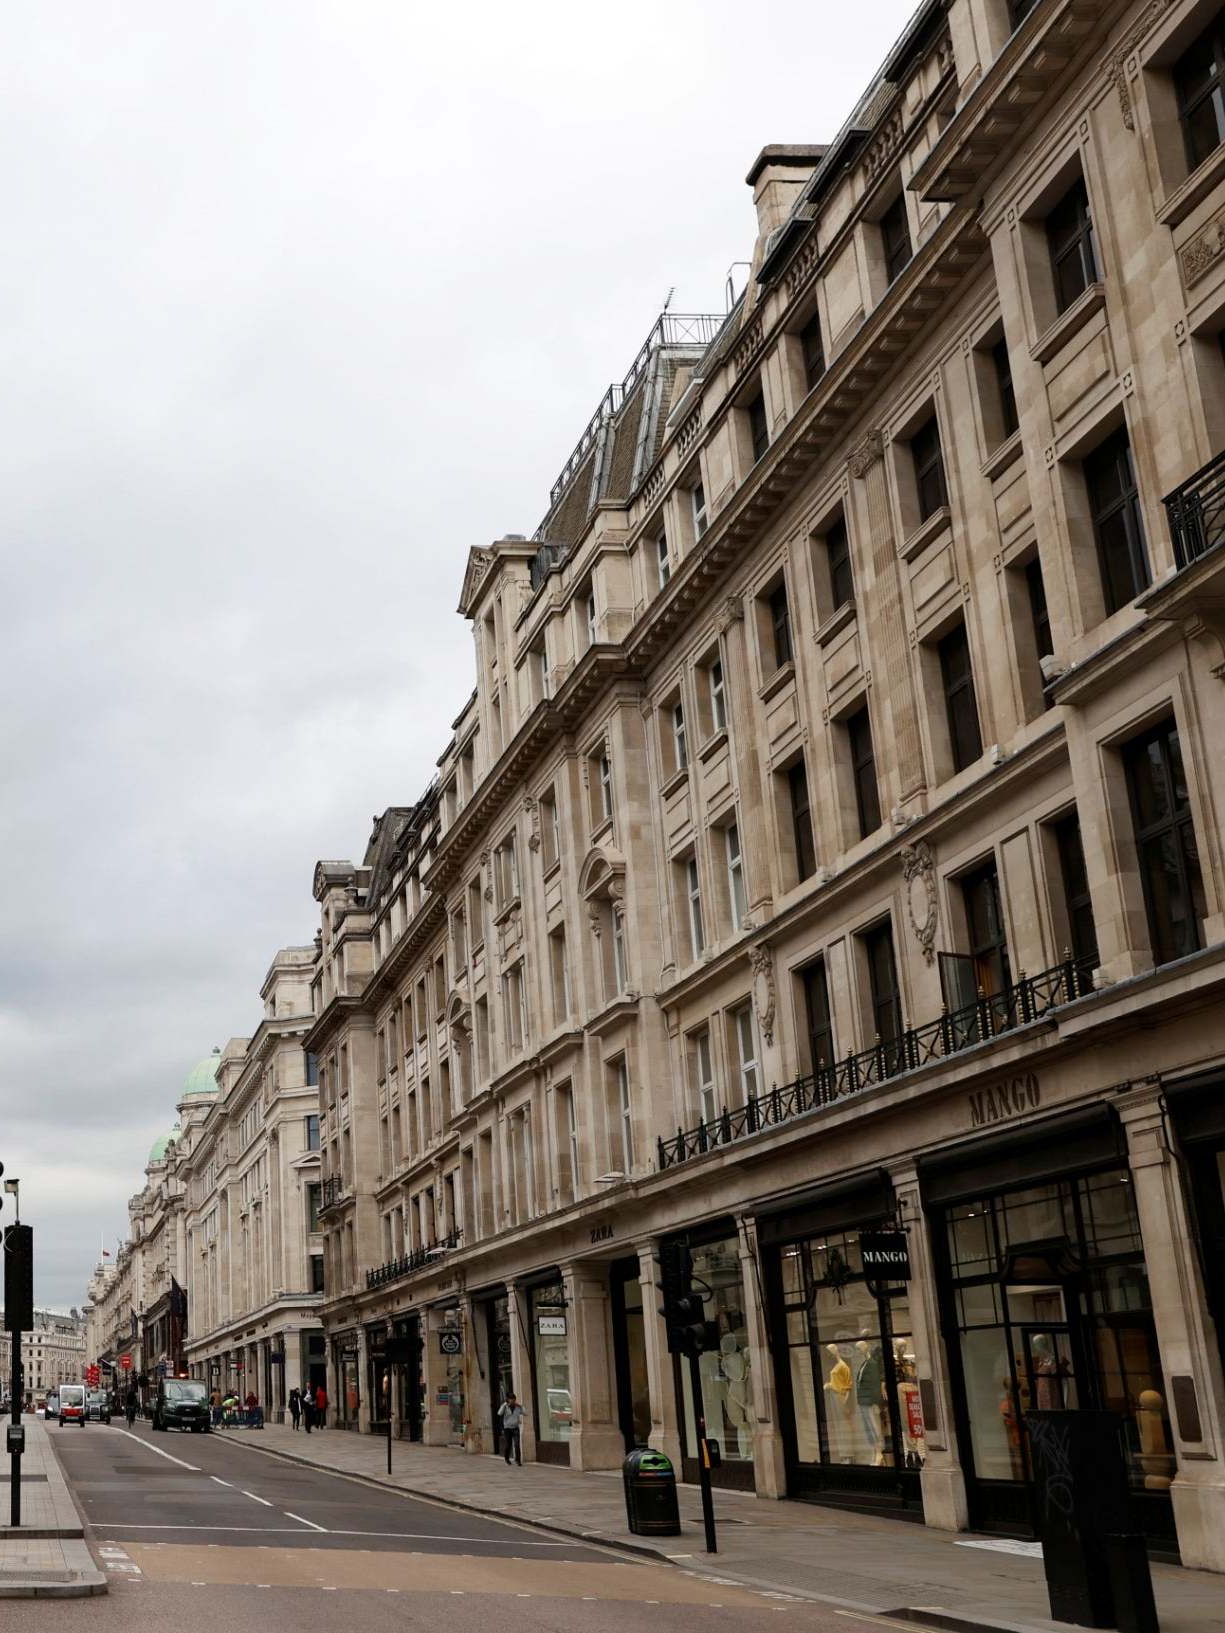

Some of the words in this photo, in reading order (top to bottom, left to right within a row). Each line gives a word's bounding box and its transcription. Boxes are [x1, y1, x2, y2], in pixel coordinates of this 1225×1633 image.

[969, 1072, 1041, 1127] MANGO
[590, 1225, 615, 1244] ZARA
[863, 1251, 908, 1263] MANGO
